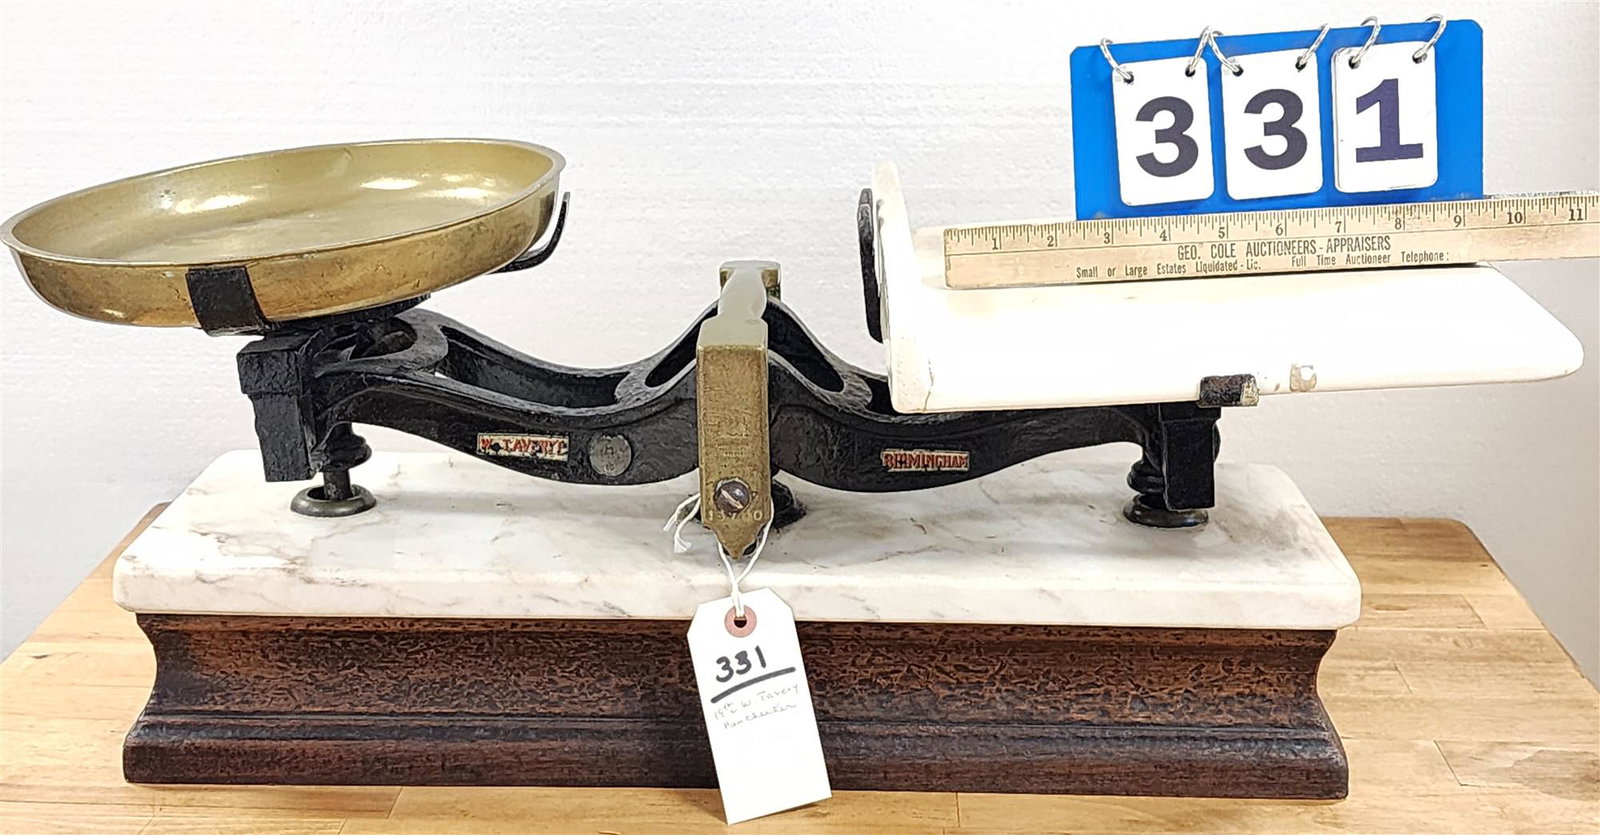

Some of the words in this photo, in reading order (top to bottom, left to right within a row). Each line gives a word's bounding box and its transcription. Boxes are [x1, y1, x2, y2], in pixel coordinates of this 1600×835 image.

[991, 237, 999, 250] 1
[1046, 235, 1055, 248] 2
[1103, 231, 1111, 244] 3
[1159, 229, 1168, 242] 4
[1217, 227, 1226, 239] 5
[1275, 223, 1284, 237] 6
[1334, 221, 1342, 233] 7
[1394, 217, 1402, 230] 8
[1453, 215, 1462, 228] 9
[1506, 211, 1523, 225] 10
[1568, 209, 1584, 222] 11
[1076, 266, 1098, 280] Small
[1107, 267, 1116, 278] or
[1125, 263, 1148, 278] Large
[1156, 261, 1187, 276] Estates
[1291, 255, 1307, 267] Full
[1316, 254, 1337, 266] Time
[1345, 252, 1392, 266] Auctioneer
[1177, 244, 1201, 261] GEO.
[1210, 242, 1236, 259] COLE
[715, 645, 767, 683] 331
